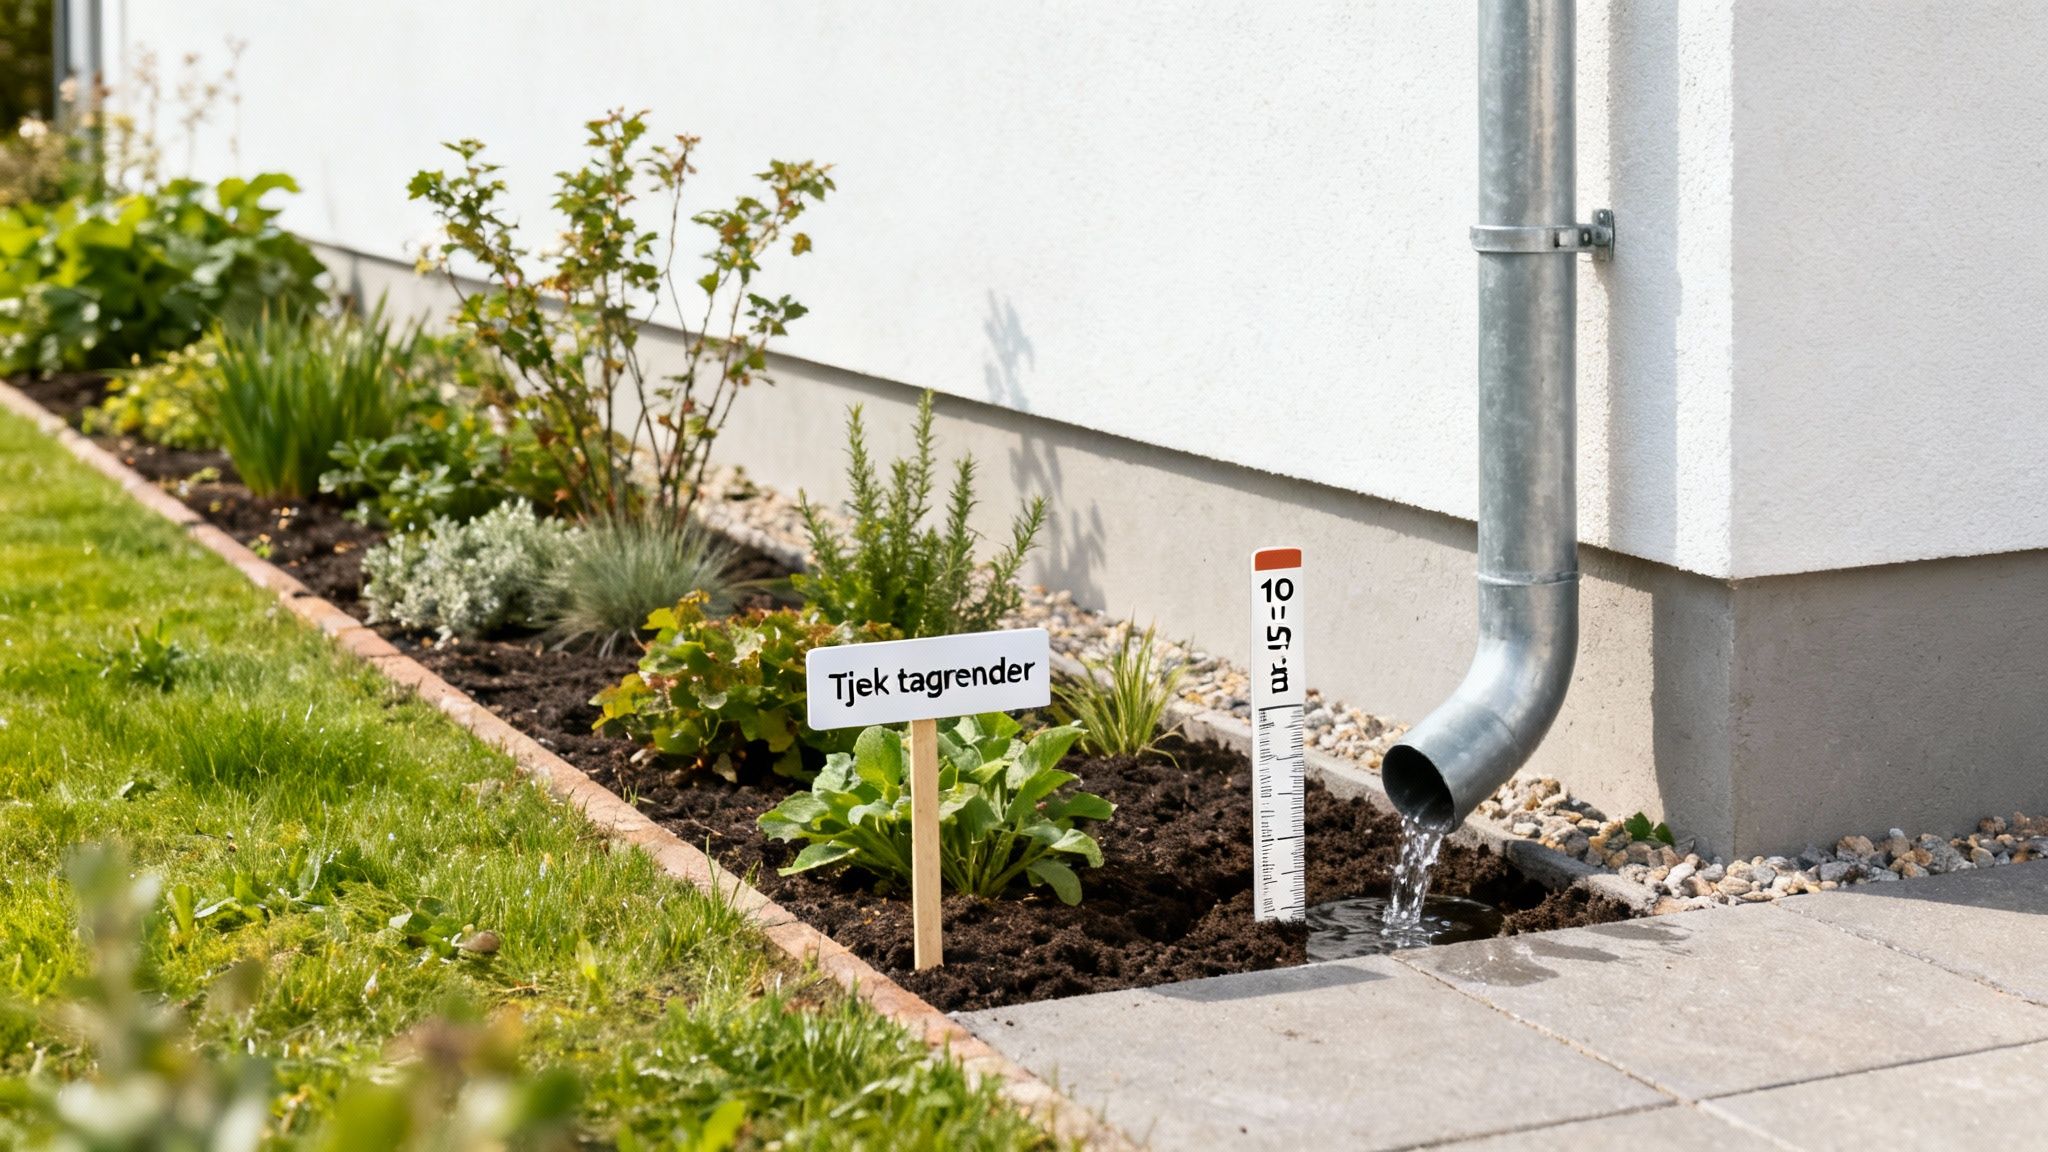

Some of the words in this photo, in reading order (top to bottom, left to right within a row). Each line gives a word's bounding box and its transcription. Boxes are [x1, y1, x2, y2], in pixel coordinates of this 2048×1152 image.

[1261, 578, 1294, 603] 10
[829, 667, 890, 707] Tjek
[897, 656, 1036, 699] tagrender
